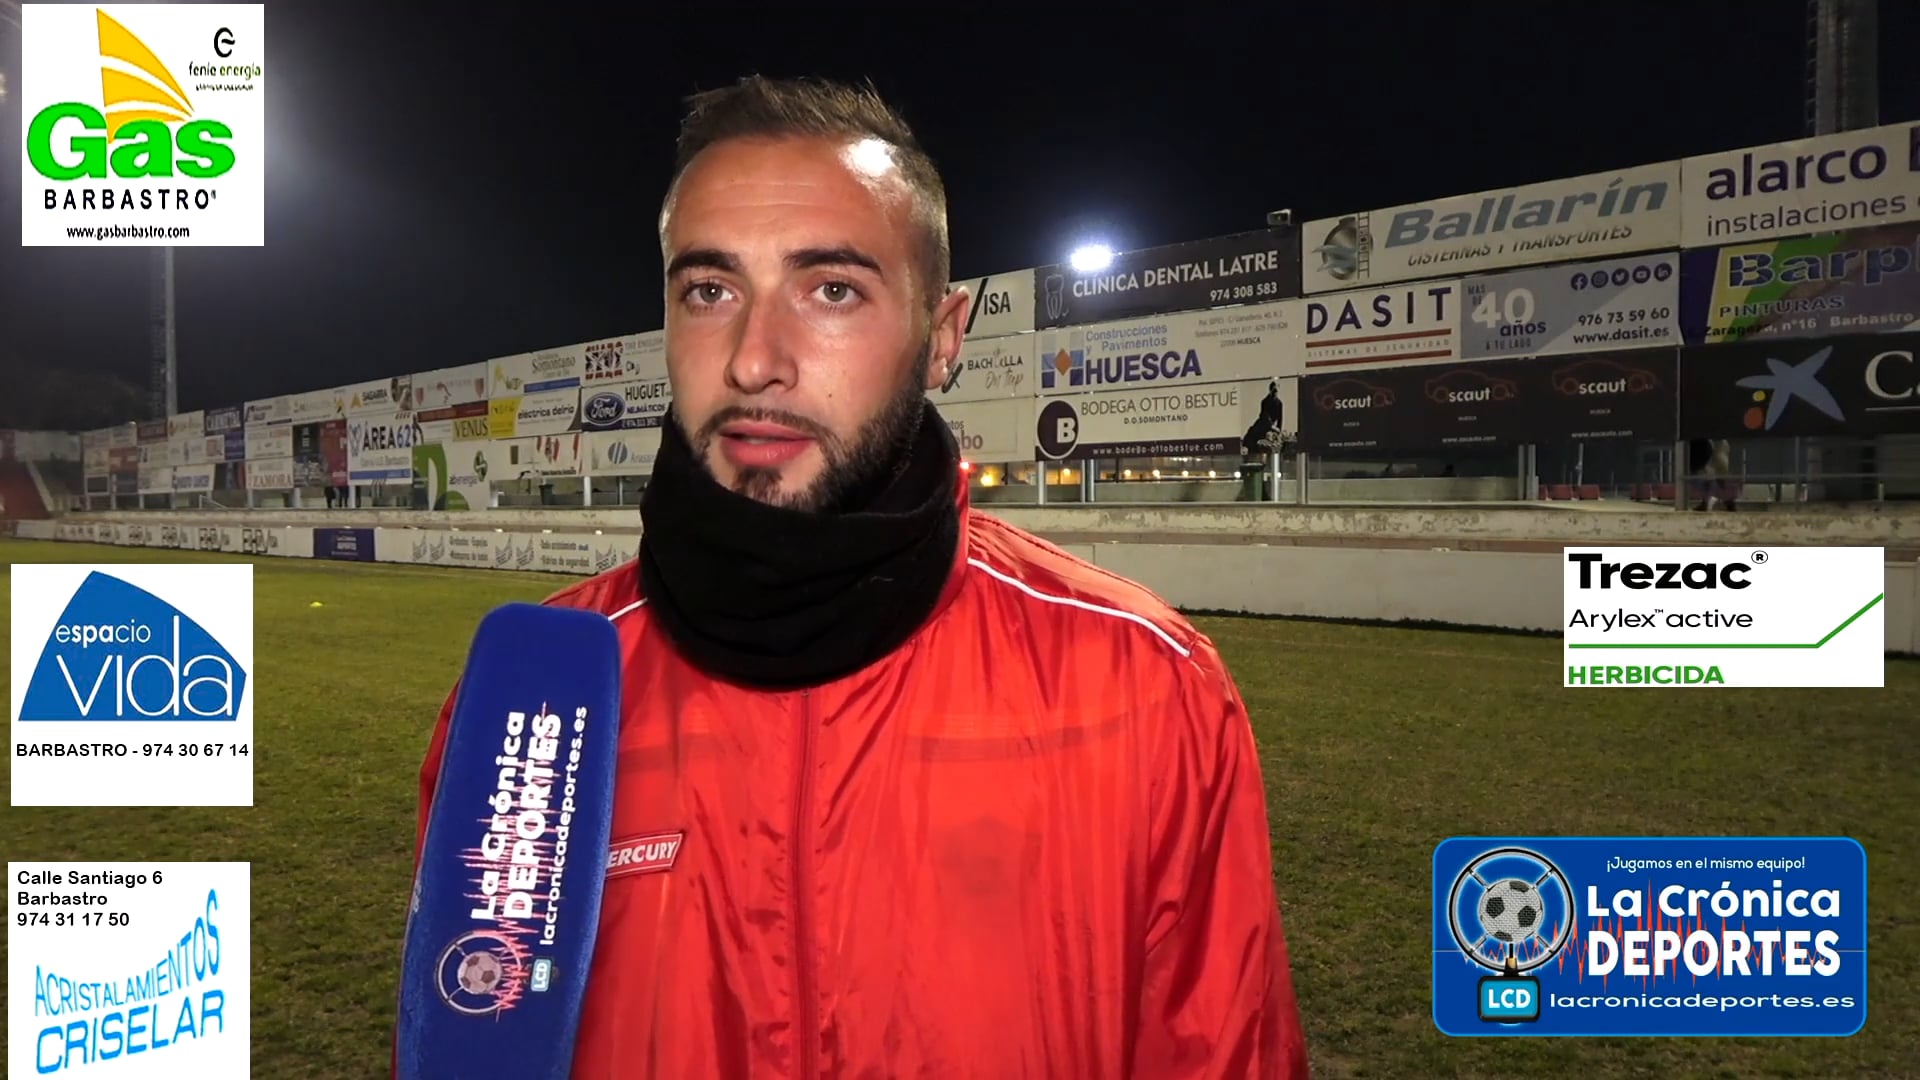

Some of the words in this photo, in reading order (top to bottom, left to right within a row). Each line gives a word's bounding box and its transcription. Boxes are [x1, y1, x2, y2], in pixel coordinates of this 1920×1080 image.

[1705, 144, 1887, 201] alarco
[1384, 176, 1669, 249] Ballarín
[1706, 194, 1907, 238] instalaciones
[1143, 262, 1214, 288] DENTAL
[1219, 250, 1279, 278] LATRE
[1727, 233, 1920, 288] Barp
[1209, 287, 1231, 302] 974
[1233, 285, 1254, 300] 308
[1256, 282, 1278, 296] 583
[1306, 286, 1452, 334] DASIT
[1472, 287, 1536, 329] 40
[1578, 312, 1603, 327] 976
[1606, 310, 1624, 325] 73
[1628, 308, 1646, 323] 59
[1650, 306, 1670, 321] 60
[1719, 296, 1844, 319] PINTURAS
[1830, 312, 1915, 329] Barbastro
[1086, 323, 1168, 342] Construcciones
[1500, 320, 1547, 337] años
[1573, 324, 1670, 345] www.dasit.es
[1101, 335, 1168, 352] Pavimentos
[1085, 349, 1202, 386] HUESCA
[1864, 350, 1920, 399] C
[625, 383, 667, 401] HUGUET
[1448, 386, 1491, 403] scaut
[1578, 377, 1627, 395] scaut
[591, 397, 618, 420] Ford
[1080, 397, 1137, 416] BODEGA
[1139, 394, 1181, 412] OTTO
[1334, 393, 1372, 410] scaut
[453, 417, 488, 438] VENUS
[1056, 417, 1075, 443] B
[481, 711, 525, 862] Crónica
[503, 713, 562, 919] DEPORTES
[540, 706, 588, 946] lacronicadeportes.es
[606, 841, 677, 868] ERCURY
[470, 870, 500, 921] La
[533, 962, 548, 989] LCD
